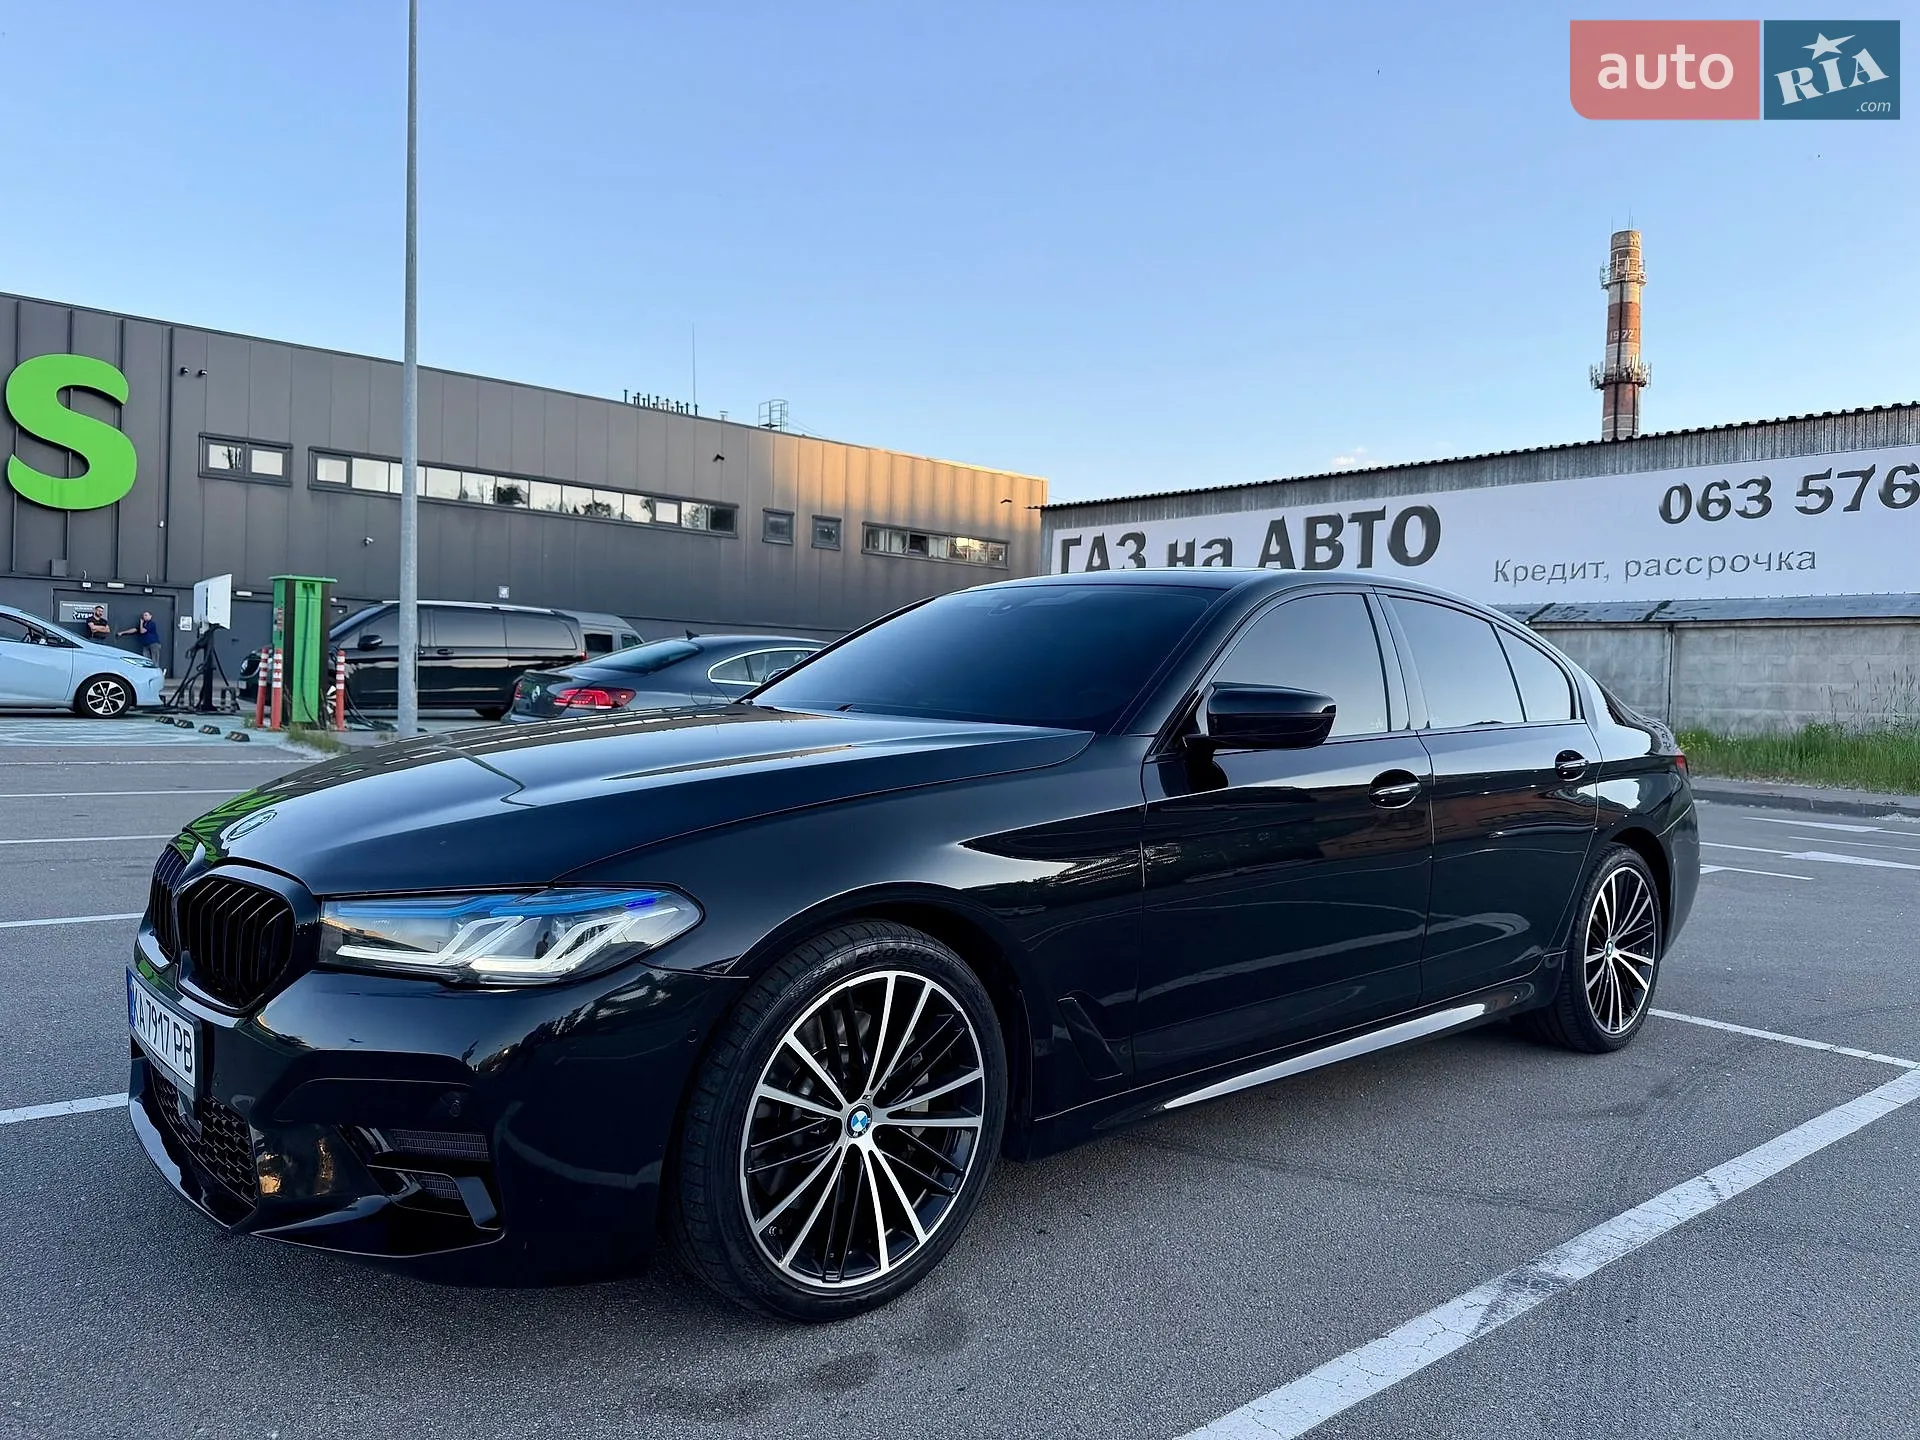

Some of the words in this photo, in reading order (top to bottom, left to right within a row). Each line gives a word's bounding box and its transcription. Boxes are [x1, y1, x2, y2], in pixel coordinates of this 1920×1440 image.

[5, 354, 137, 510] S
[1658, 474, 1773, 524] 063
[1059, 531, 1147, 574] ГАЗ
[1167, 536, 1234, 568] на
[1257, 504, 1442, 571] АВТО
[1494, 558, 1611, 586] Кредит,
[1624, 547, 1817, 581] рассрочка
[146, 999, 169, 1056] 7917
[173, 1022, 193, 1073] PB
